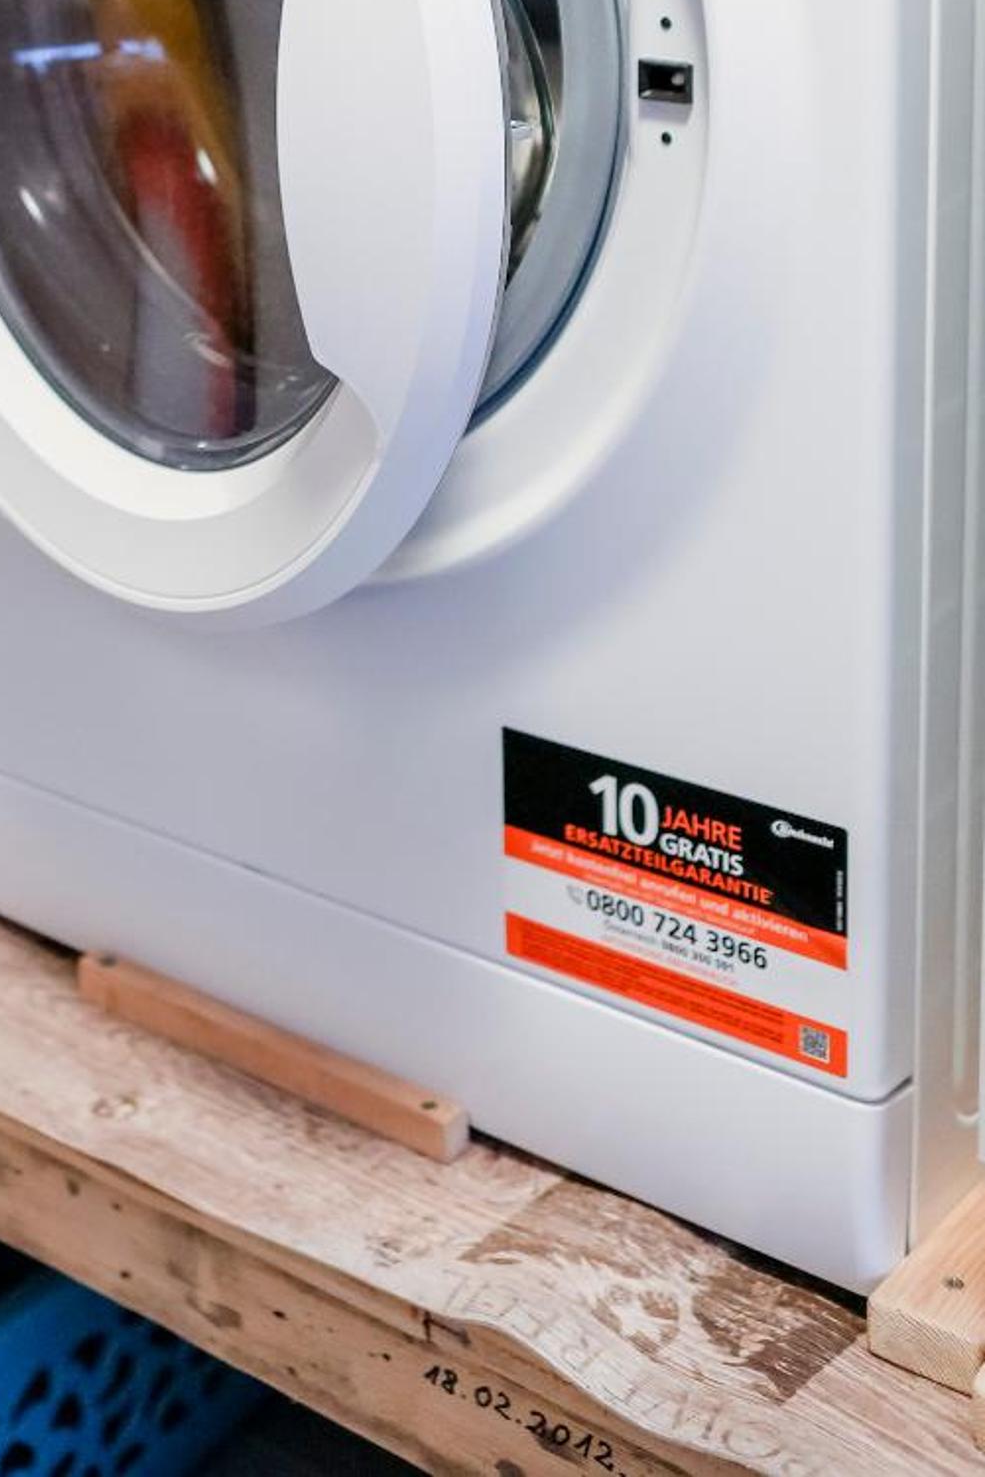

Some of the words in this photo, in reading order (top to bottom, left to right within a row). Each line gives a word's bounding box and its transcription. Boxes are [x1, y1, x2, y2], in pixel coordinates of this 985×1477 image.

[588, 774, 660, 847] 10
[662, 805, 744, 852] JAHRE
[659, 832, 745, 877] GRATIS
[586, 888, 645, 927] 0800
[653, 910, 698, 946] 724
[706, 929, 768, 969] 3966
